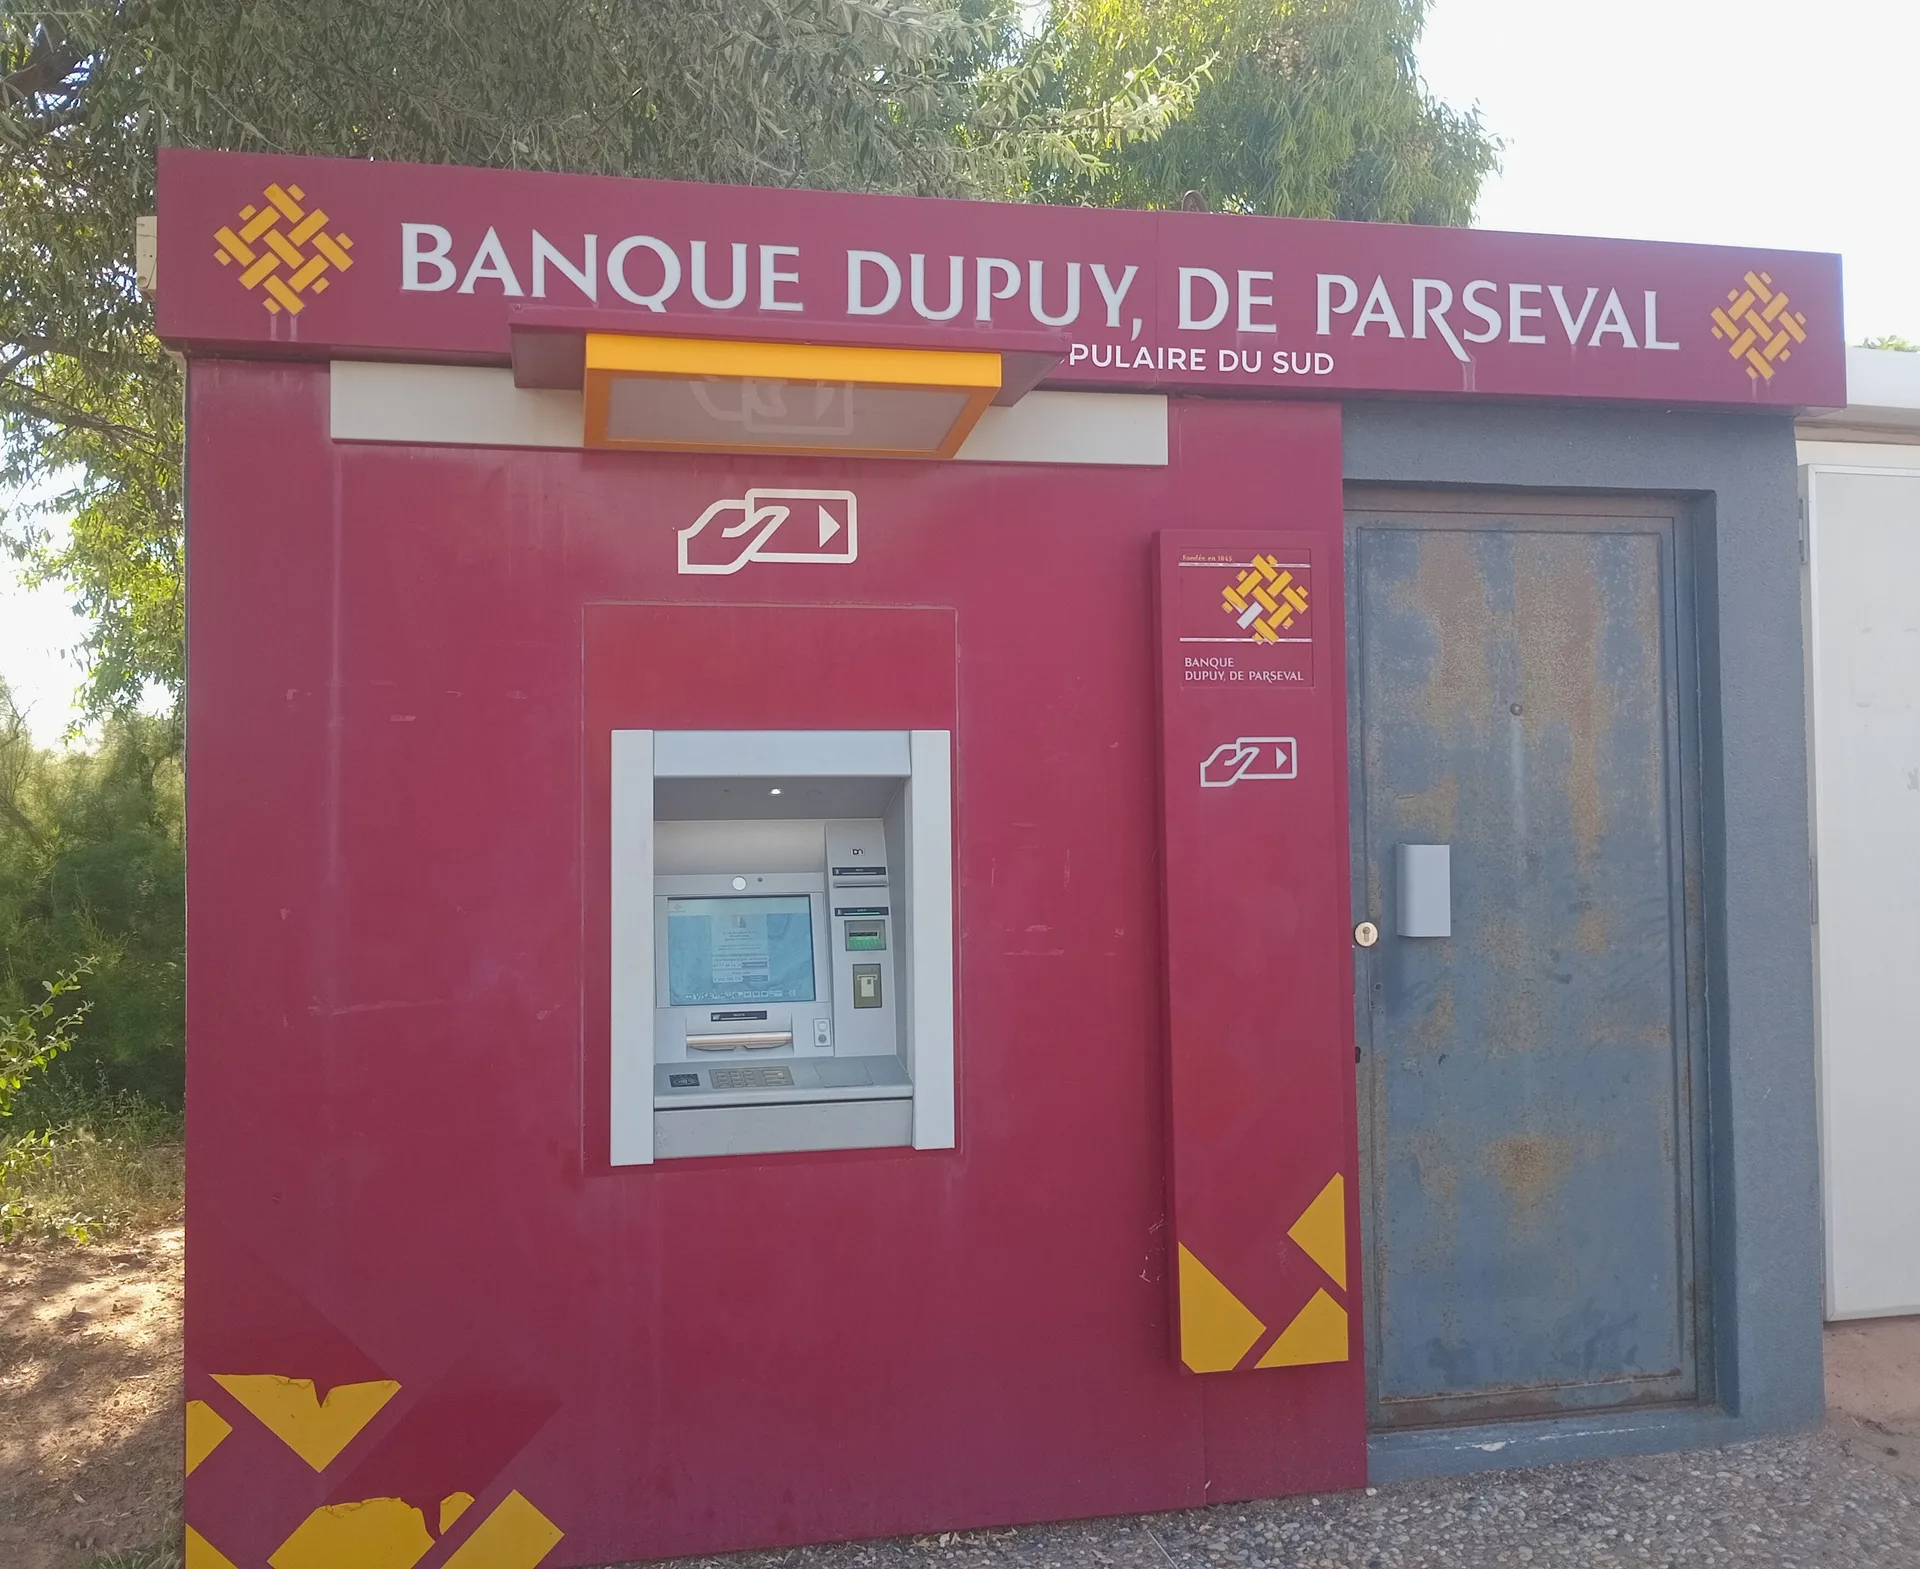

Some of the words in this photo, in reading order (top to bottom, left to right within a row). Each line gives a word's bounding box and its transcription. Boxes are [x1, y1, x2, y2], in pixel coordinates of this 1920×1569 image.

[401, 222, 804, 313] BANQUE
[846, 250, 1143, 341] DUPUY,
[1177, 266, 1277, 333] DE
[1316, 273, 1680, 363] PARSEVAL
[1060, 343, 1207, 371] PULAIRE
[1218, 349, 1262, 373] DU
[1272, 351, 1335, 375] SUD
[1184, 657, 1235, 670] BANQUE
[1229, 671, 1245, 681] DE
[1248, 671, 1304, 684] PARSEVAL
